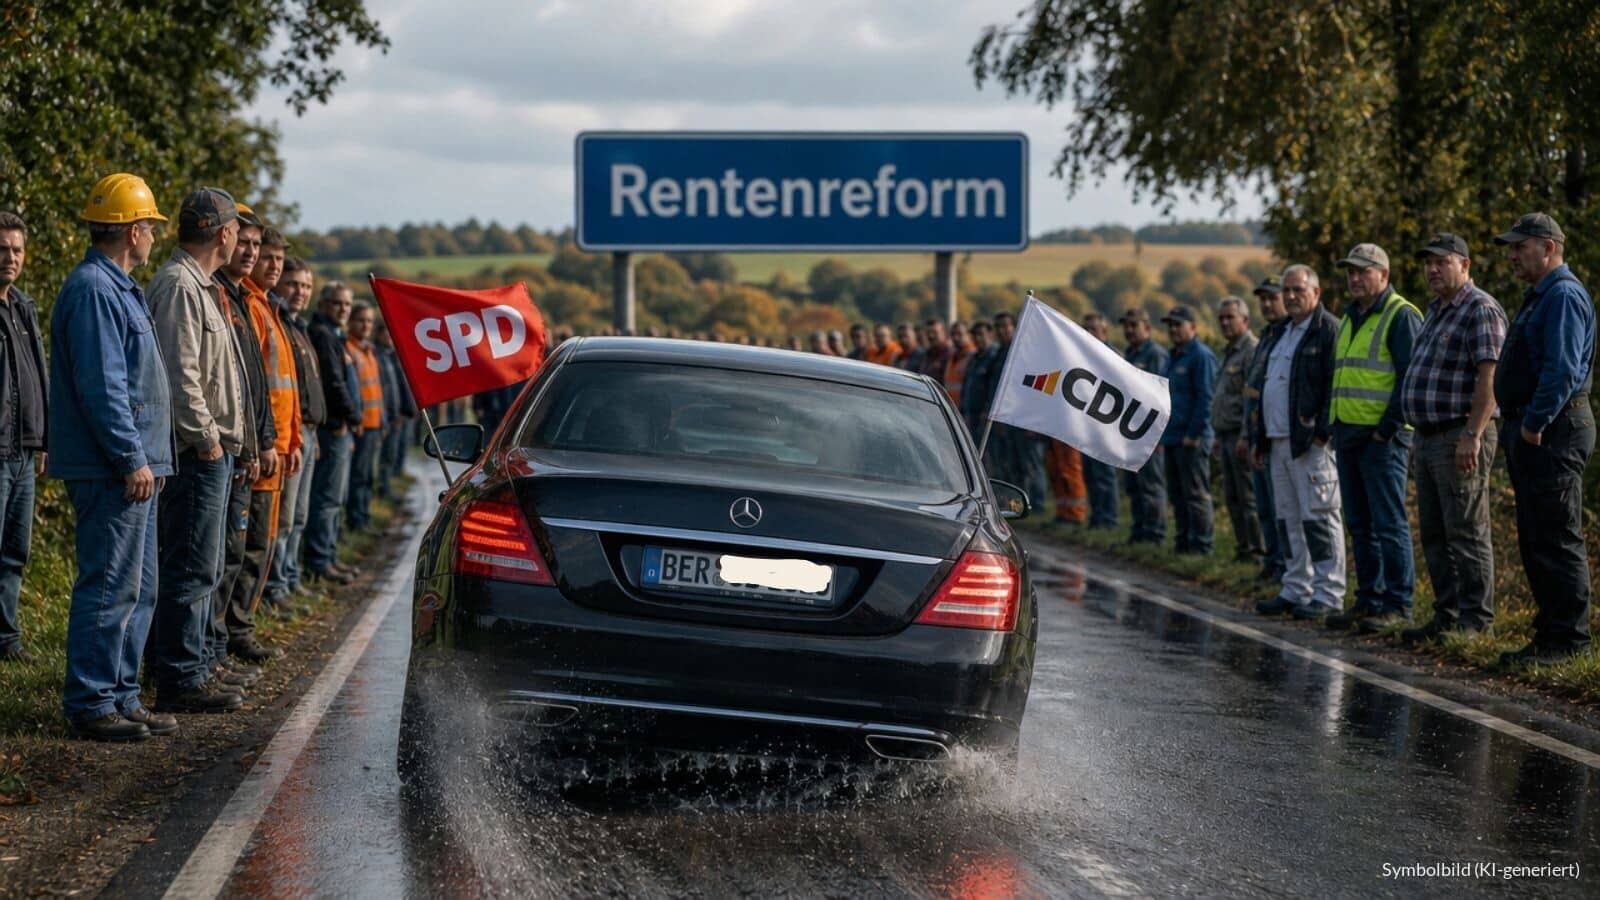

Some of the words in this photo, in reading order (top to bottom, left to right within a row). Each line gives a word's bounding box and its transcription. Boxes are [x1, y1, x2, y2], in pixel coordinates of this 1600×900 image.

[610, 164, 1006, 218] Rentenreform
[414, 304, 526, 373] SPD
[1061, 367, 1160, 441] CDU
[662, 553, 710, 585] BER
